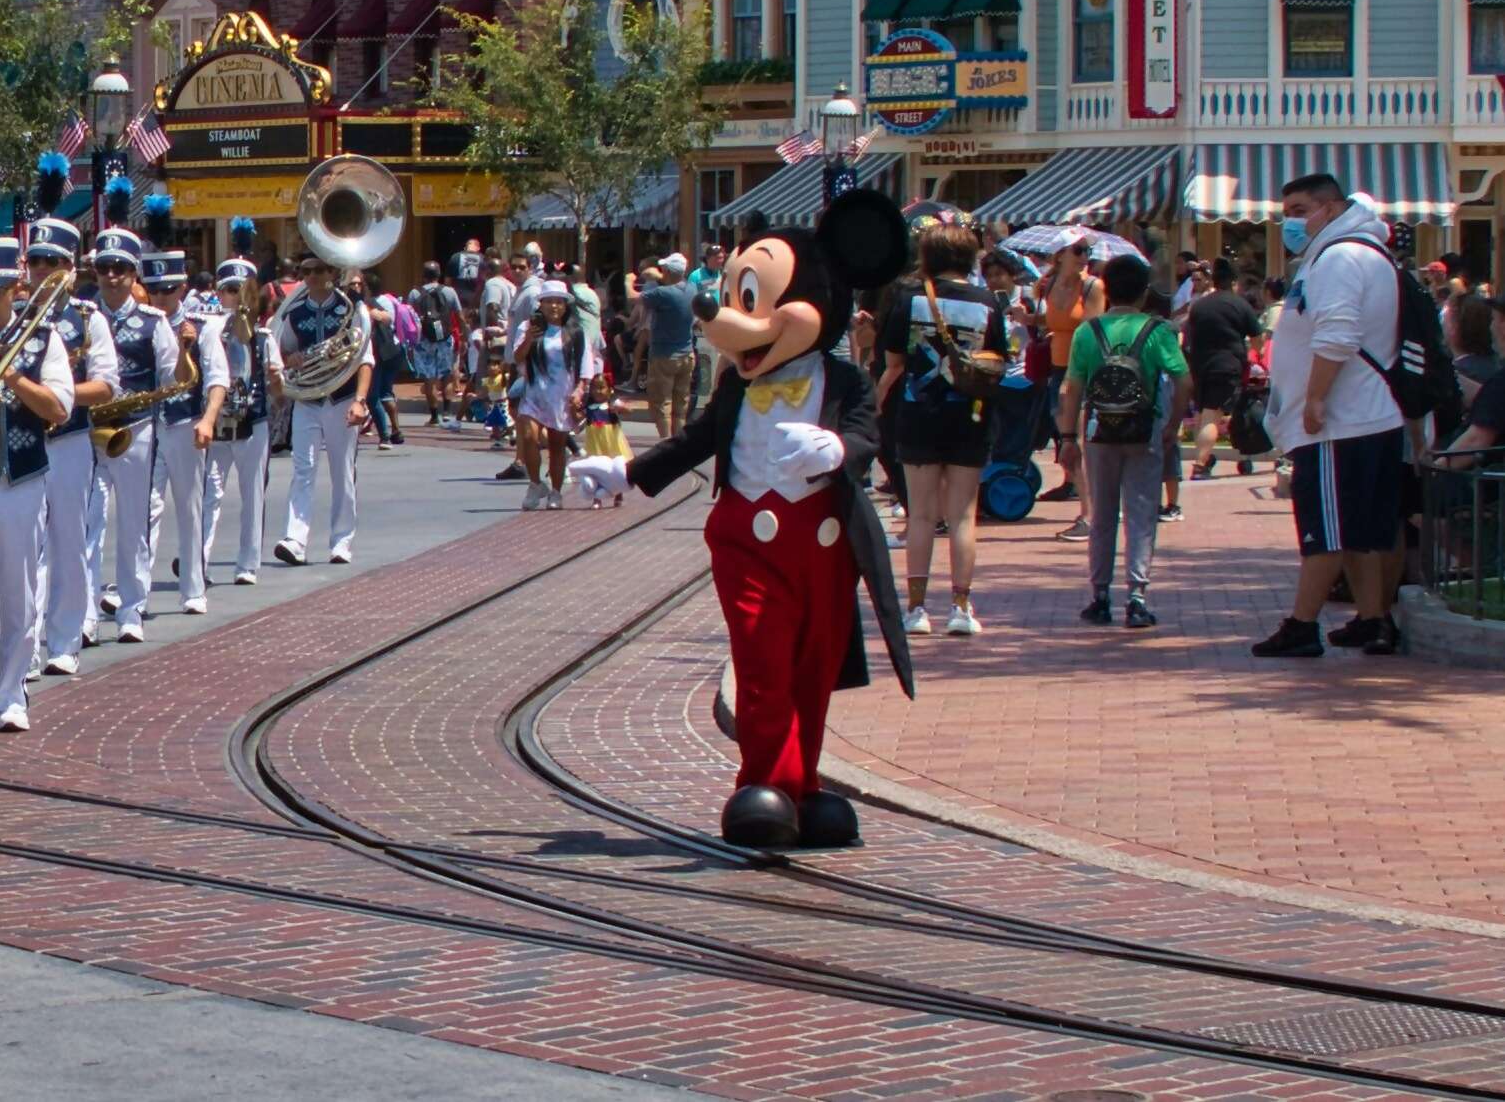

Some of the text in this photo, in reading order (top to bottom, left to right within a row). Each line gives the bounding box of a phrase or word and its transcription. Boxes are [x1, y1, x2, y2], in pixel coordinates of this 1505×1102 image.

[897, 41, 922, 53] MAIN
[966, 69, 1017, 91] JOKES
[196, 71, 283, 105] CINEMA
[894, 111, 923, 124] STREET
[208, 128, 262, 143] STEAMBOAT
[220, 146, 250, 159] WILLIE
[925, 140, 975, 155] HOUDINI
